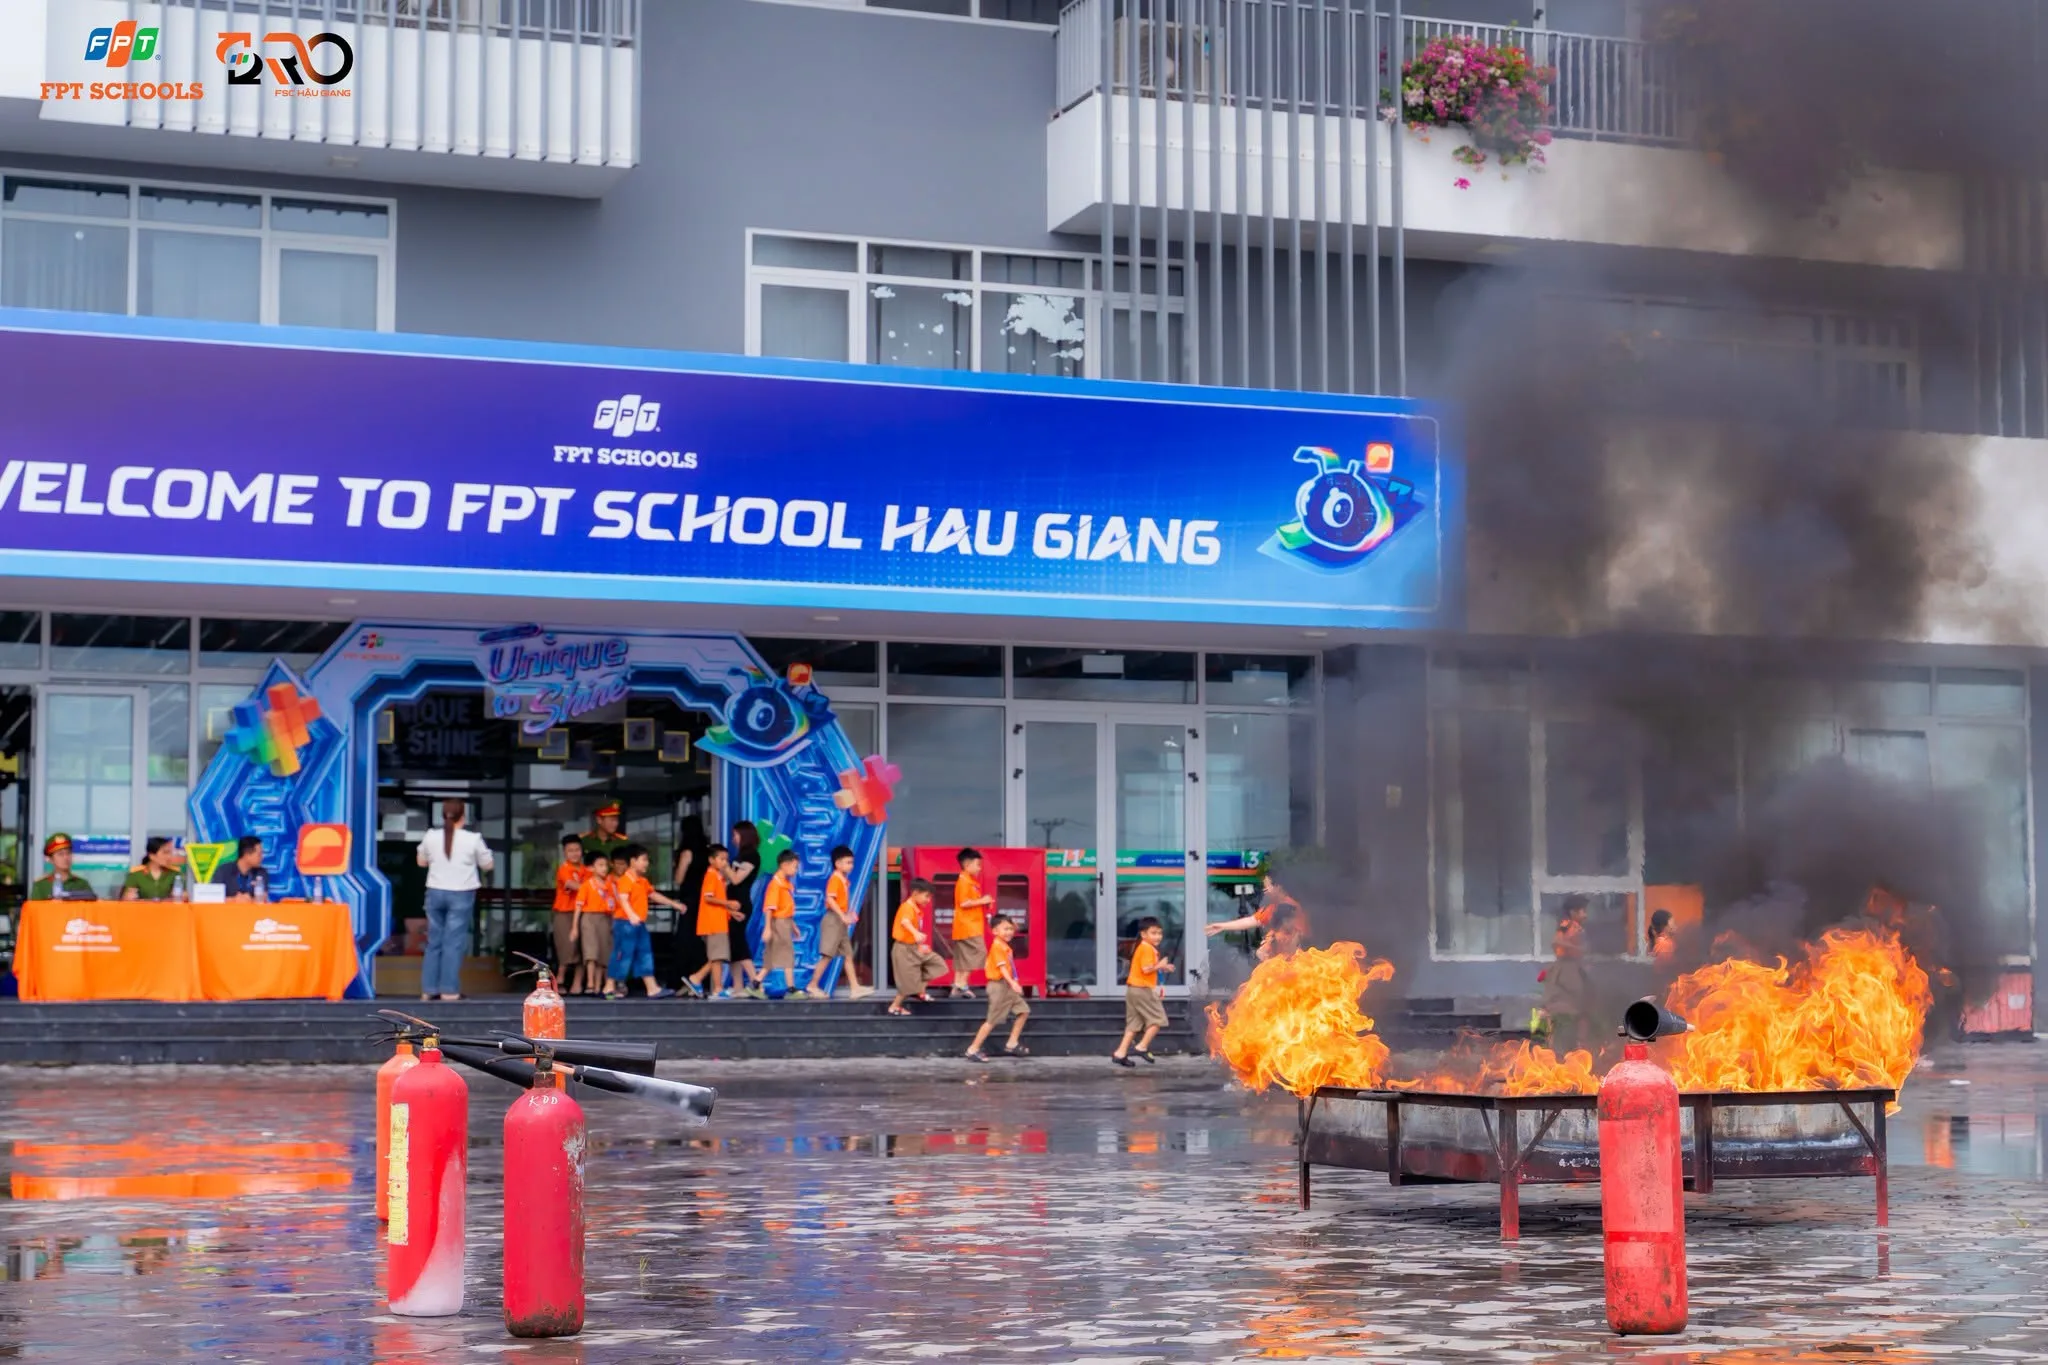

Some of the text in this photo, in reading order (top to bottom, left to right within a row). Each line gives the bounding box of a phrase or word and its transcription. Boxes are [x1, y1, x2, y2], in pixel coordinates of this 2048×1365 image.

[553, 445, 698, 470] FPT SCHOOLS
[338, 476, 432, 530] TO
[447, 482, 576, 536] FPT
[588, 489, 863, 550] SCHOOL
[880, 504, 1018, 557] HAU
[1032, 513, 1222, 566] GIANG
[488, 632, 629, 685] Unique
[523, 674, 630, 734] Shine
[408, 729, 483, 756] SHINE
